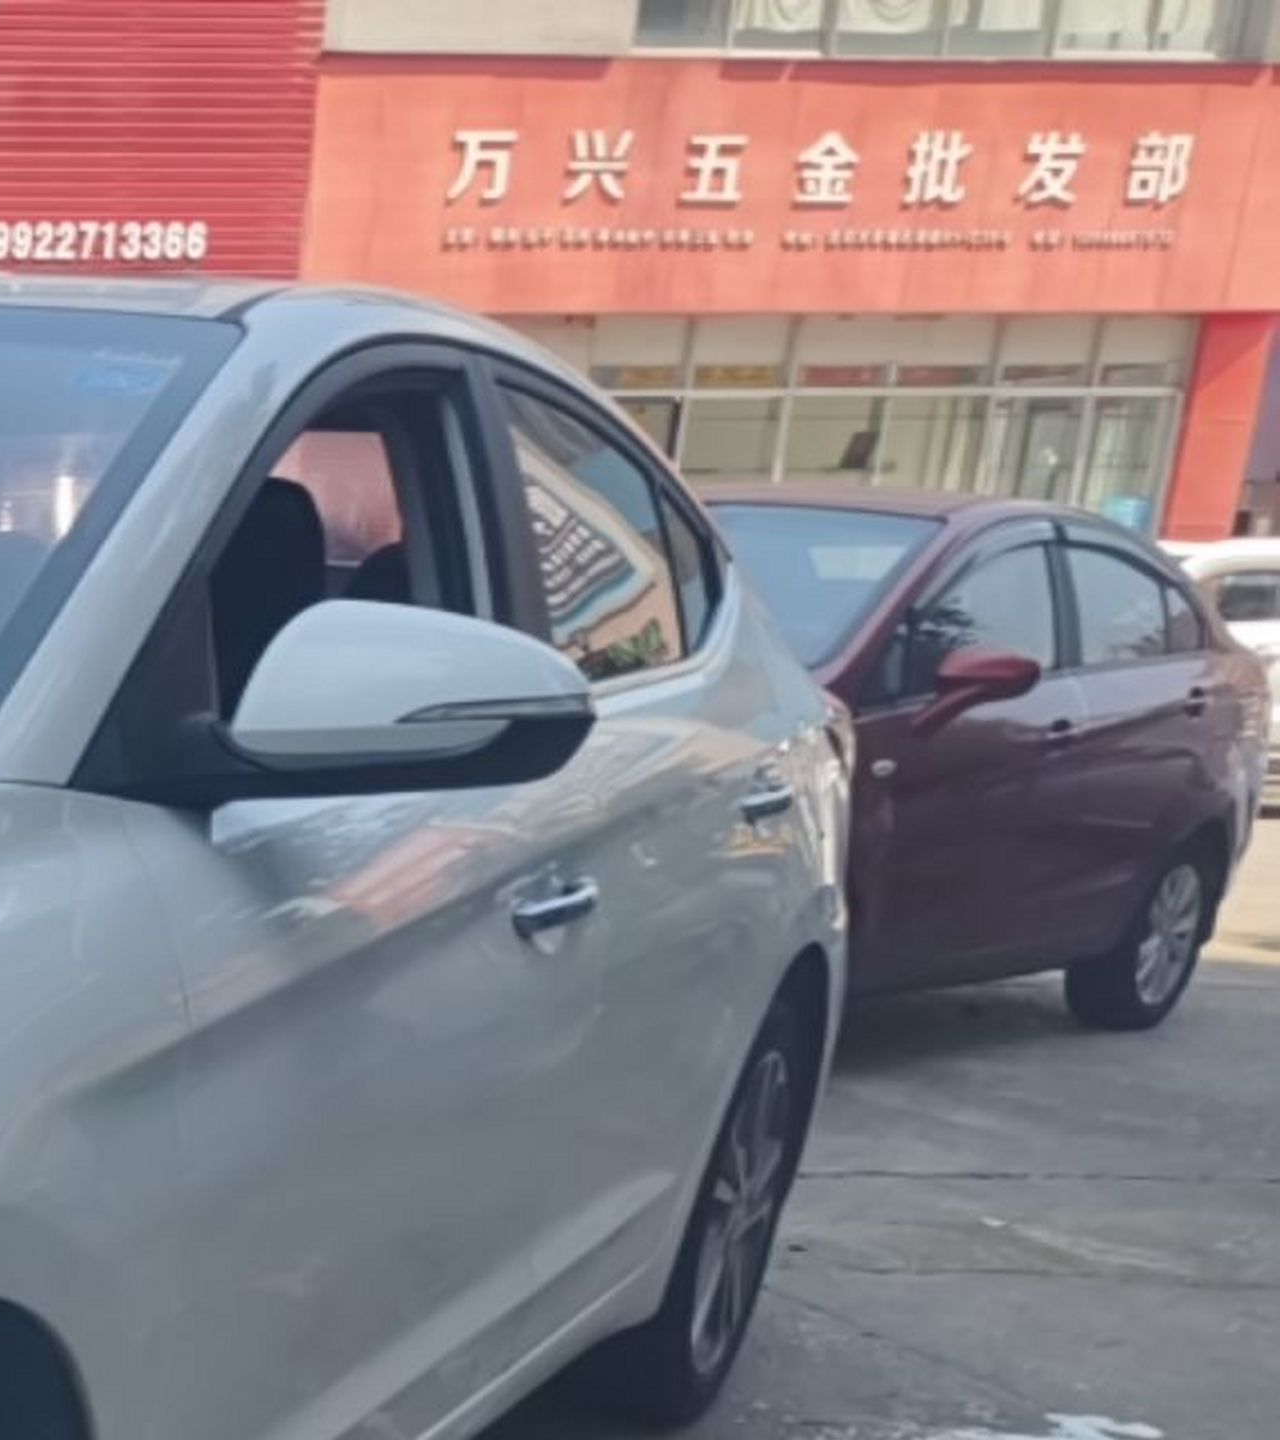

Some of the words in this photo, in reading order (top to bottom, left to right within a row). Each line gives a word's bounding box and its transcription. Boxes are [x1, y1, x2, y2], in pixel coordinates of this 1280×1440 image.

[444, 128, 1198, 203] 万兴五金批发部
